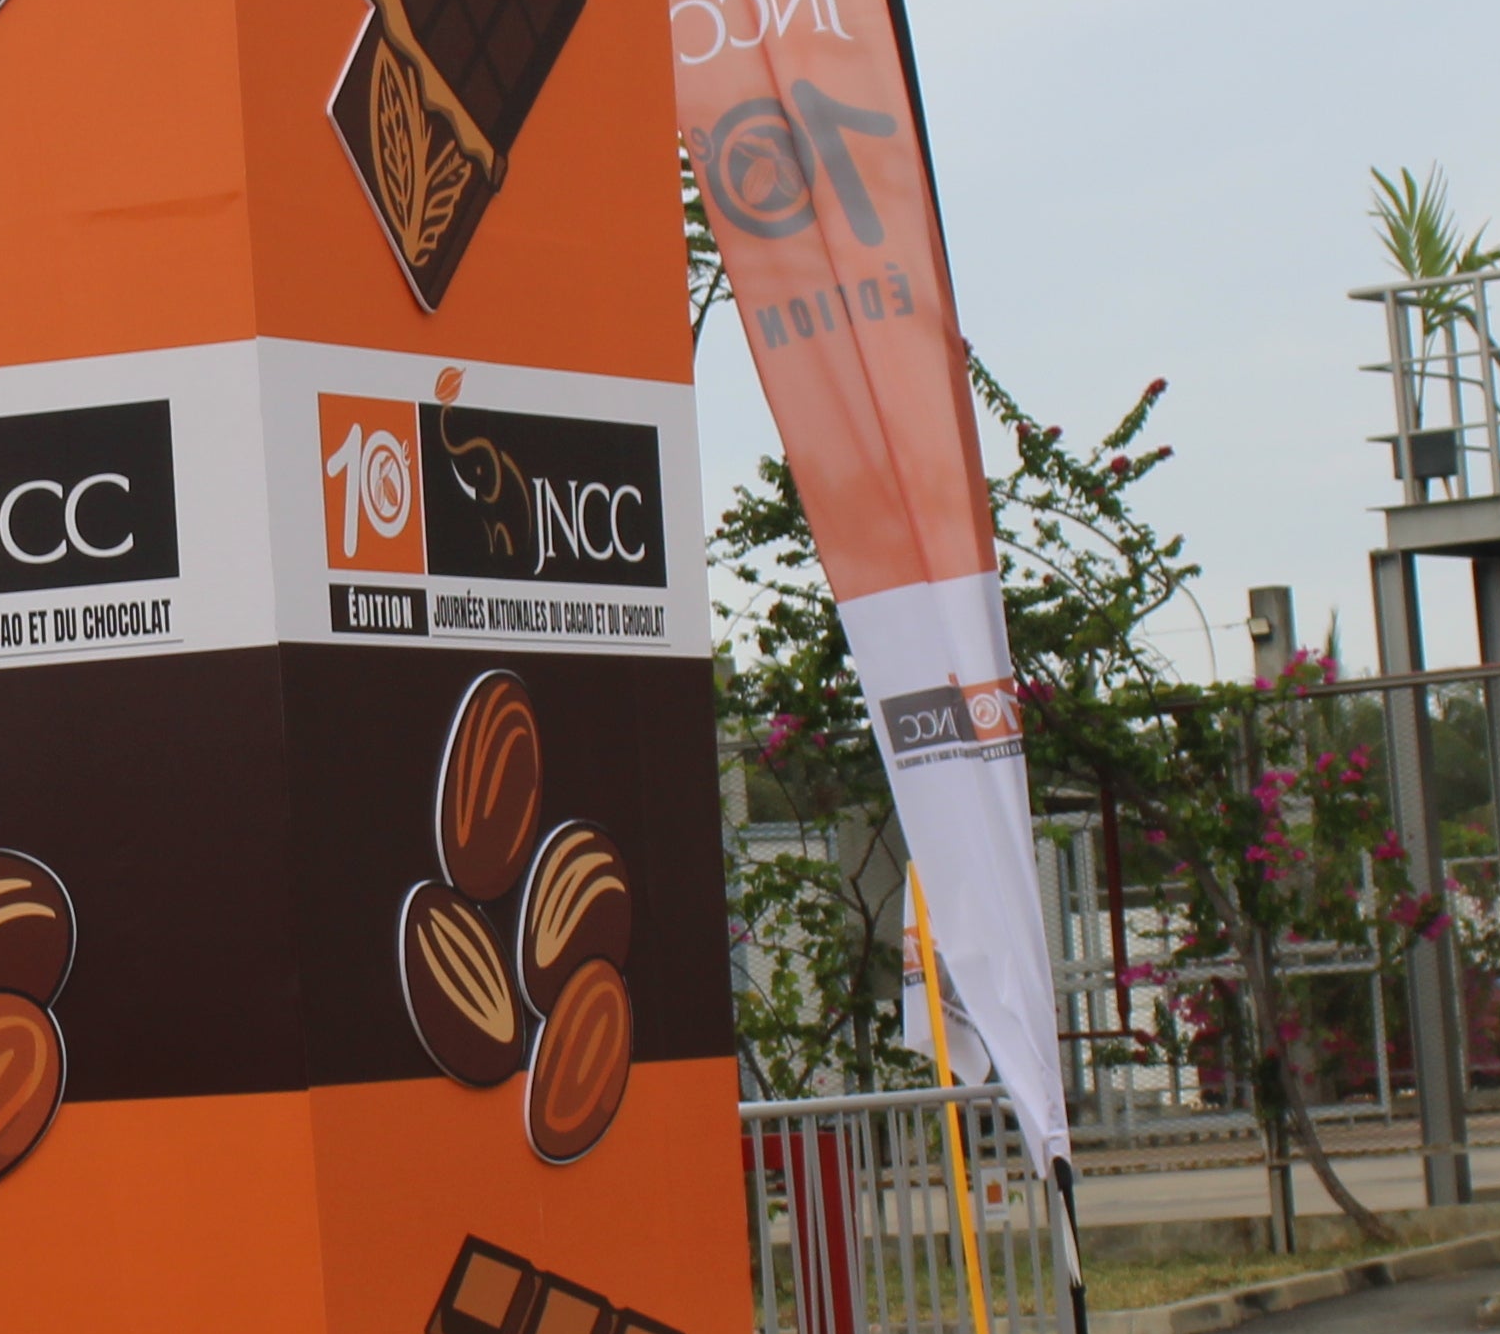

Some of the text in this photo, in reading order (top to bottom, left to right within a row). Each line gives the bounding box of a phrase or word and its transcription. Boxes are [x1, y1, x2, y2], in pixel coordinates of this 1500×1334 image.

[532, 477, 646, 576] JNCC
[29, 610, 48, 645] ET
[53, 607, 78, 643] DU
[82, 599, 172, 640] CHOCOLAT
[348, 586, 413, 630] ÉDITION
[433, 588, 666, 638] JOURNÉES NATIONALES DU CACAO ET DU CHOCOLAT
